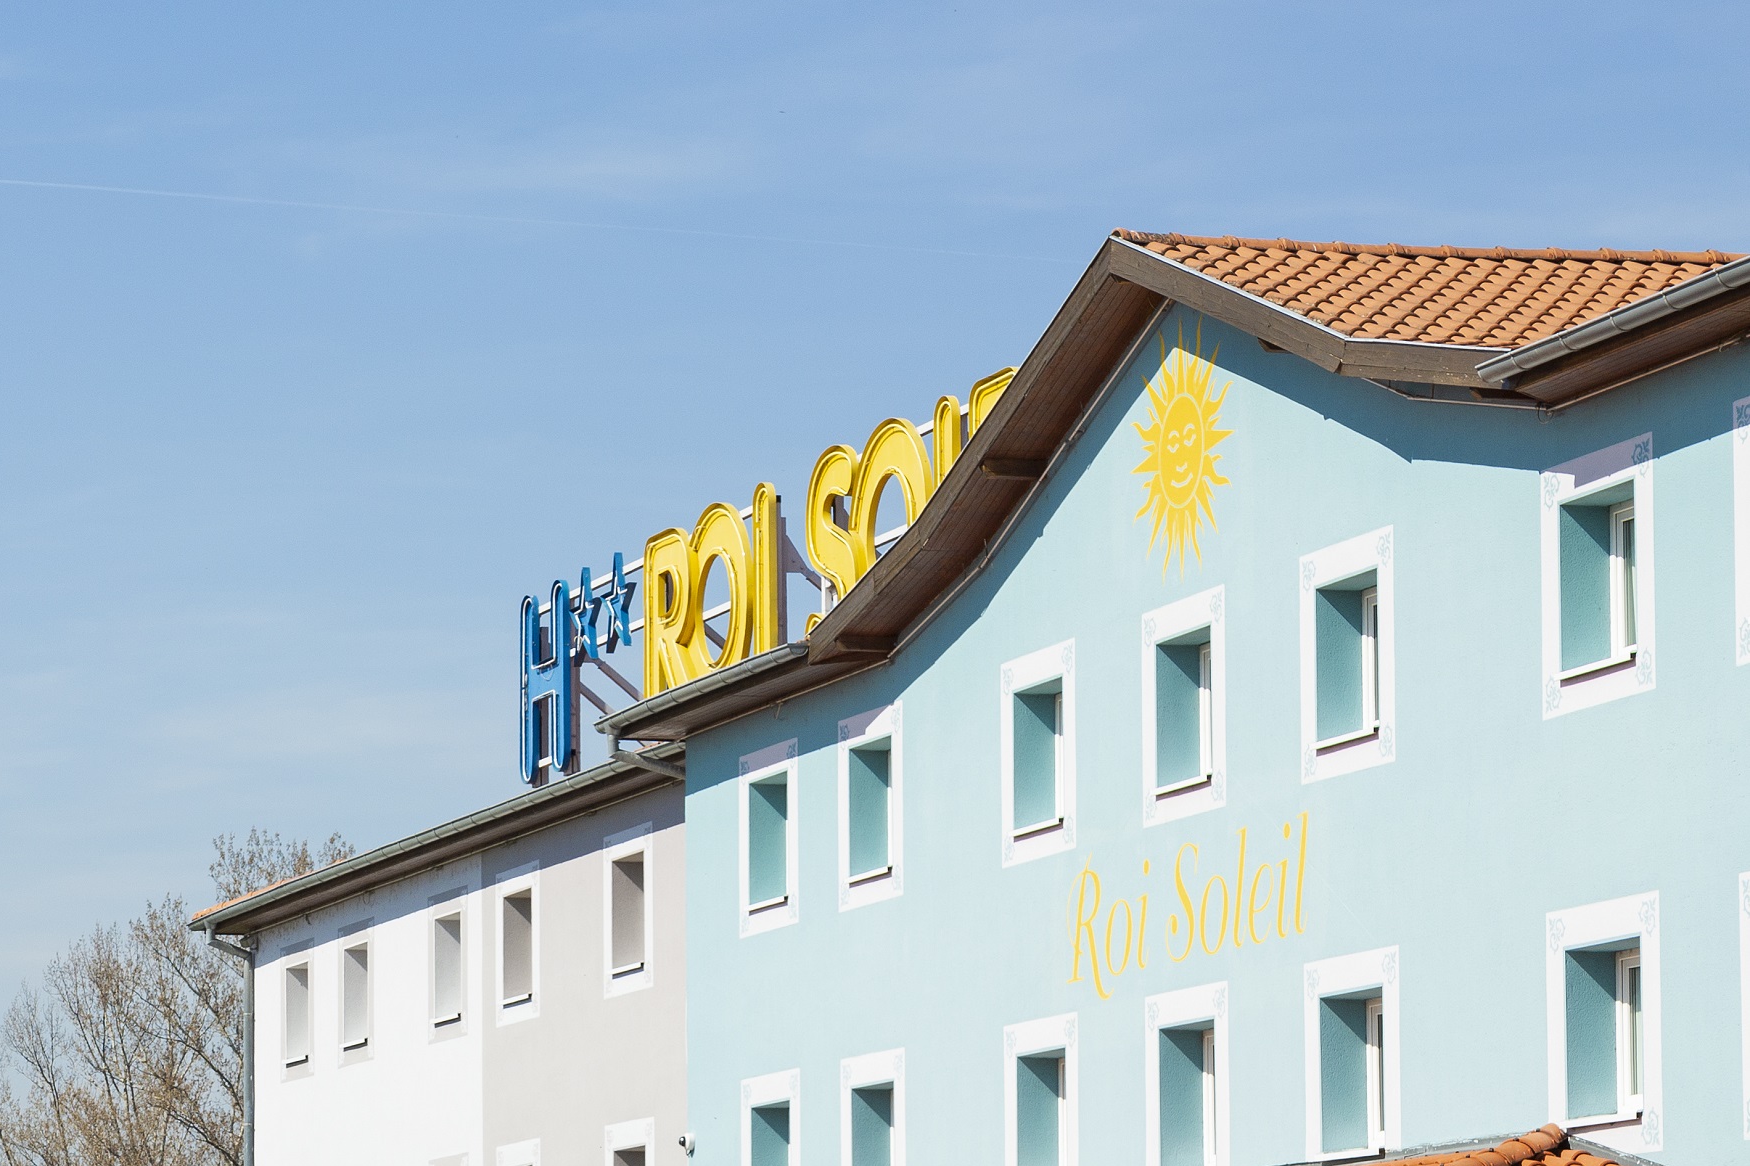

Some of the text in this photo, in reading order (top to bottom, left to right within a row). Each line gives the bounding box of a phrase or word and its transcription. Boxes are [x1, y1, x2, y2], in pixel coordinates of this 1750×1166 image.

[644, 482, 777, 698] ROI
[805, 366, 1020, 640] SO
[1066, 810, 1308, 1001] Roi Soleil
